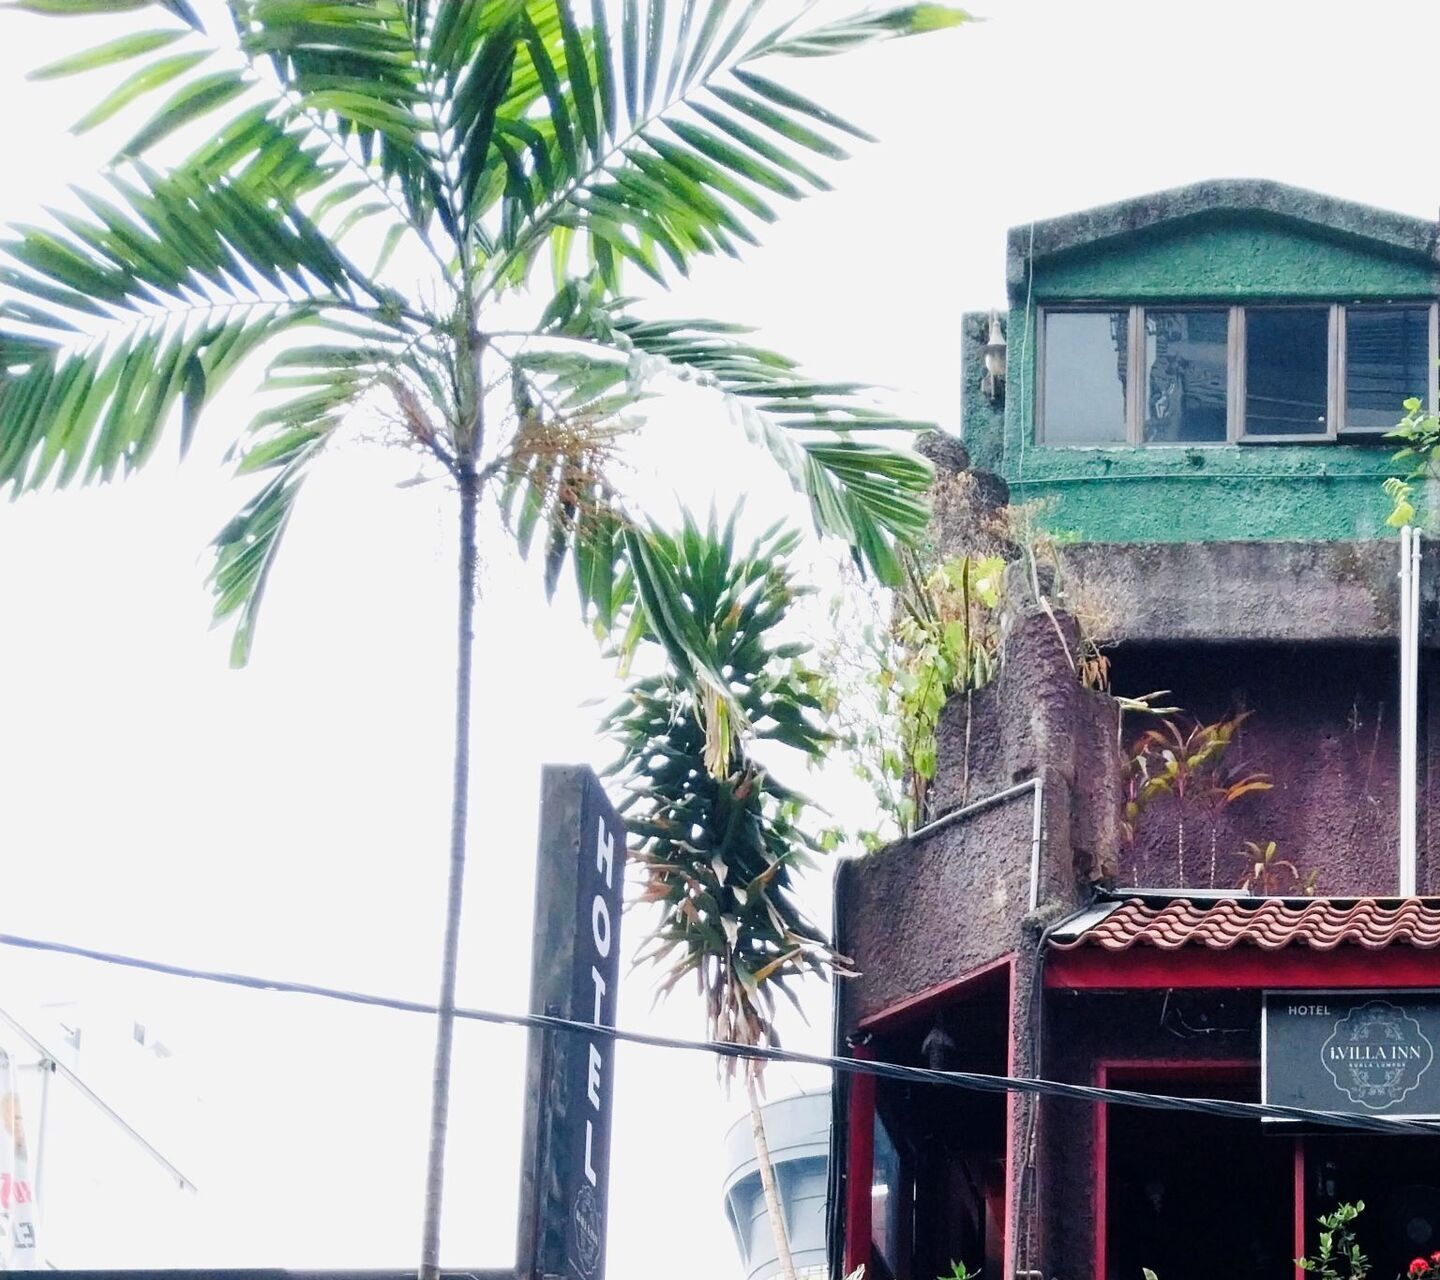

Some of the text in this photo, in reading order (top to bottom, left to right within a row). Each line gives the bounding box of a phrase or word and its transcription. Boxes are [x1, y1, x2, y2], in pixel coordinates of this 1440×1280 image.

[584, 814, 616, 1188] HOTEL
[1288, 1005, 1331, 1016] HOTEL
[1330, 1045, 1421, 1060] i.VILLA INN
